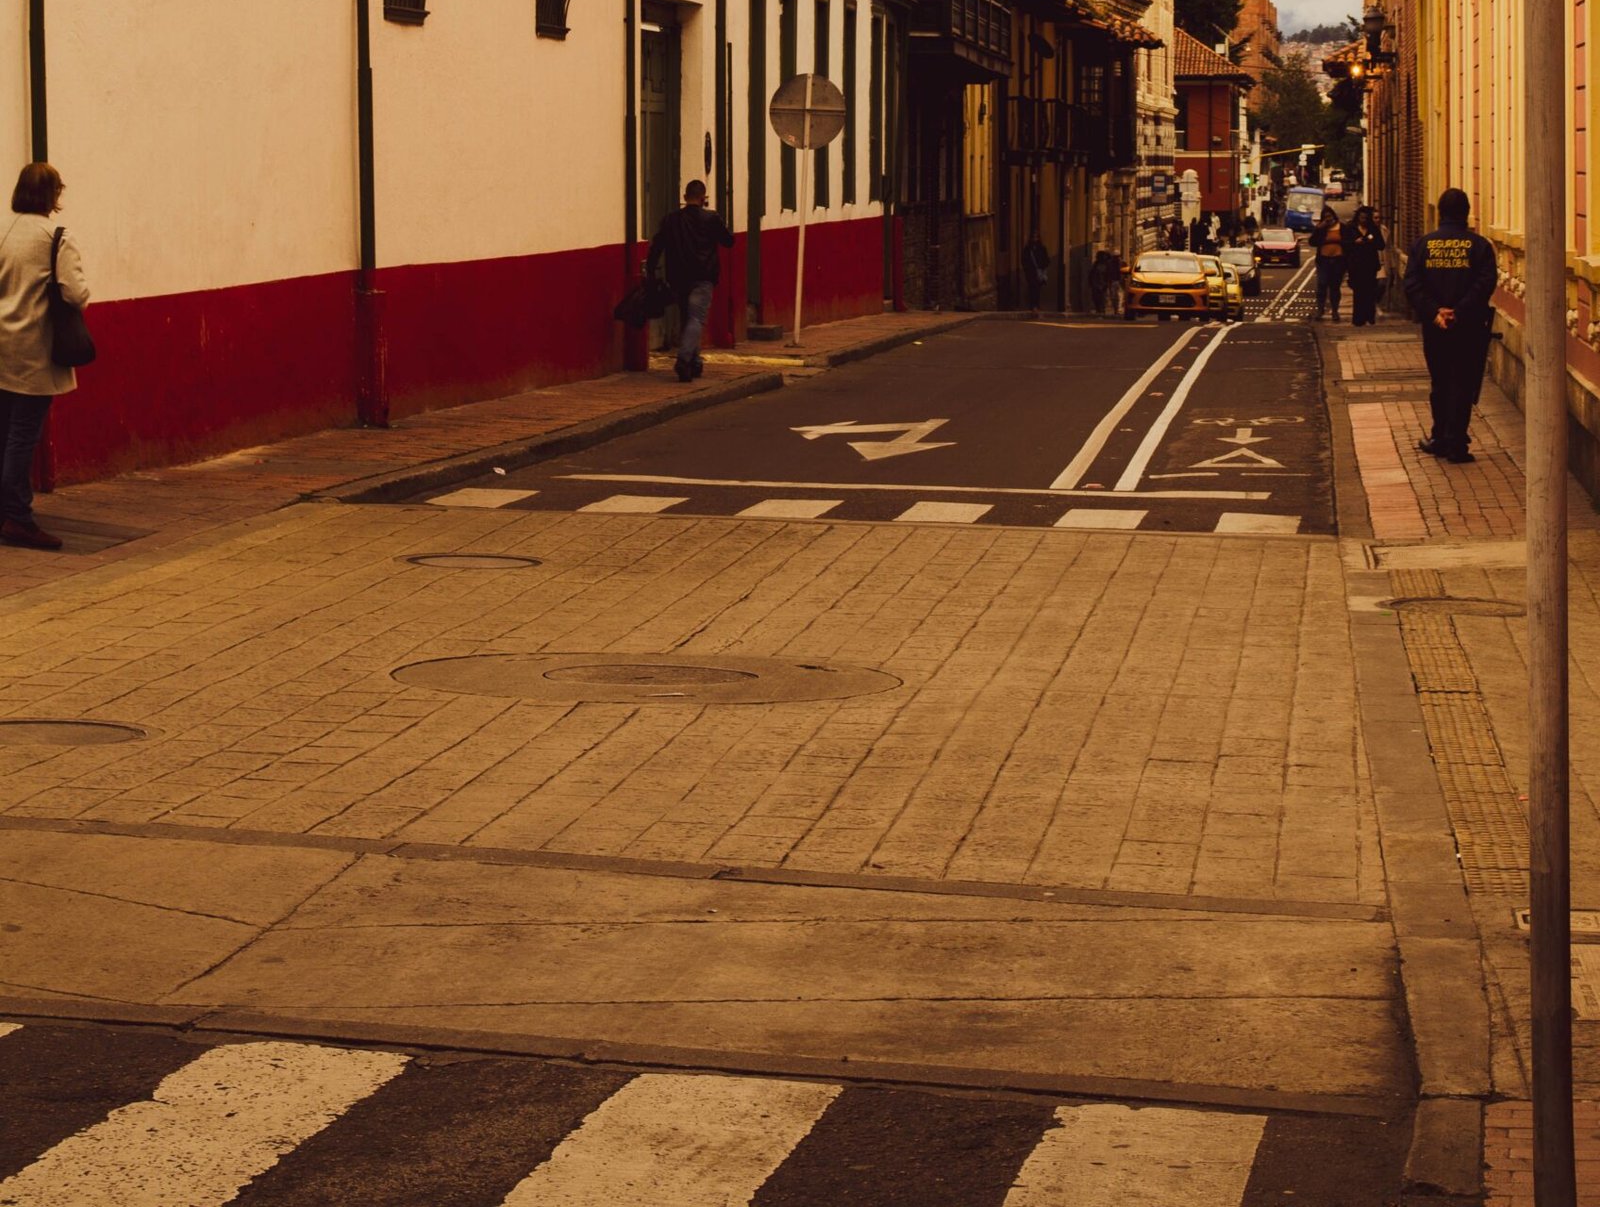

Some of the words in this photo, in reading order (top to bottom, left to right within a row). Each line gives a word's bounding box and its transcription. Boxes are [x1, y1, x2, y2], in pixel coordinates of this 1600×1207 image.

[1427, 239, 1472, 249] SEGURIDAD
[1429, 248, 1467, 258] PRIVADA
[1426, 258, 1470, 268] INTERGLOBAL
